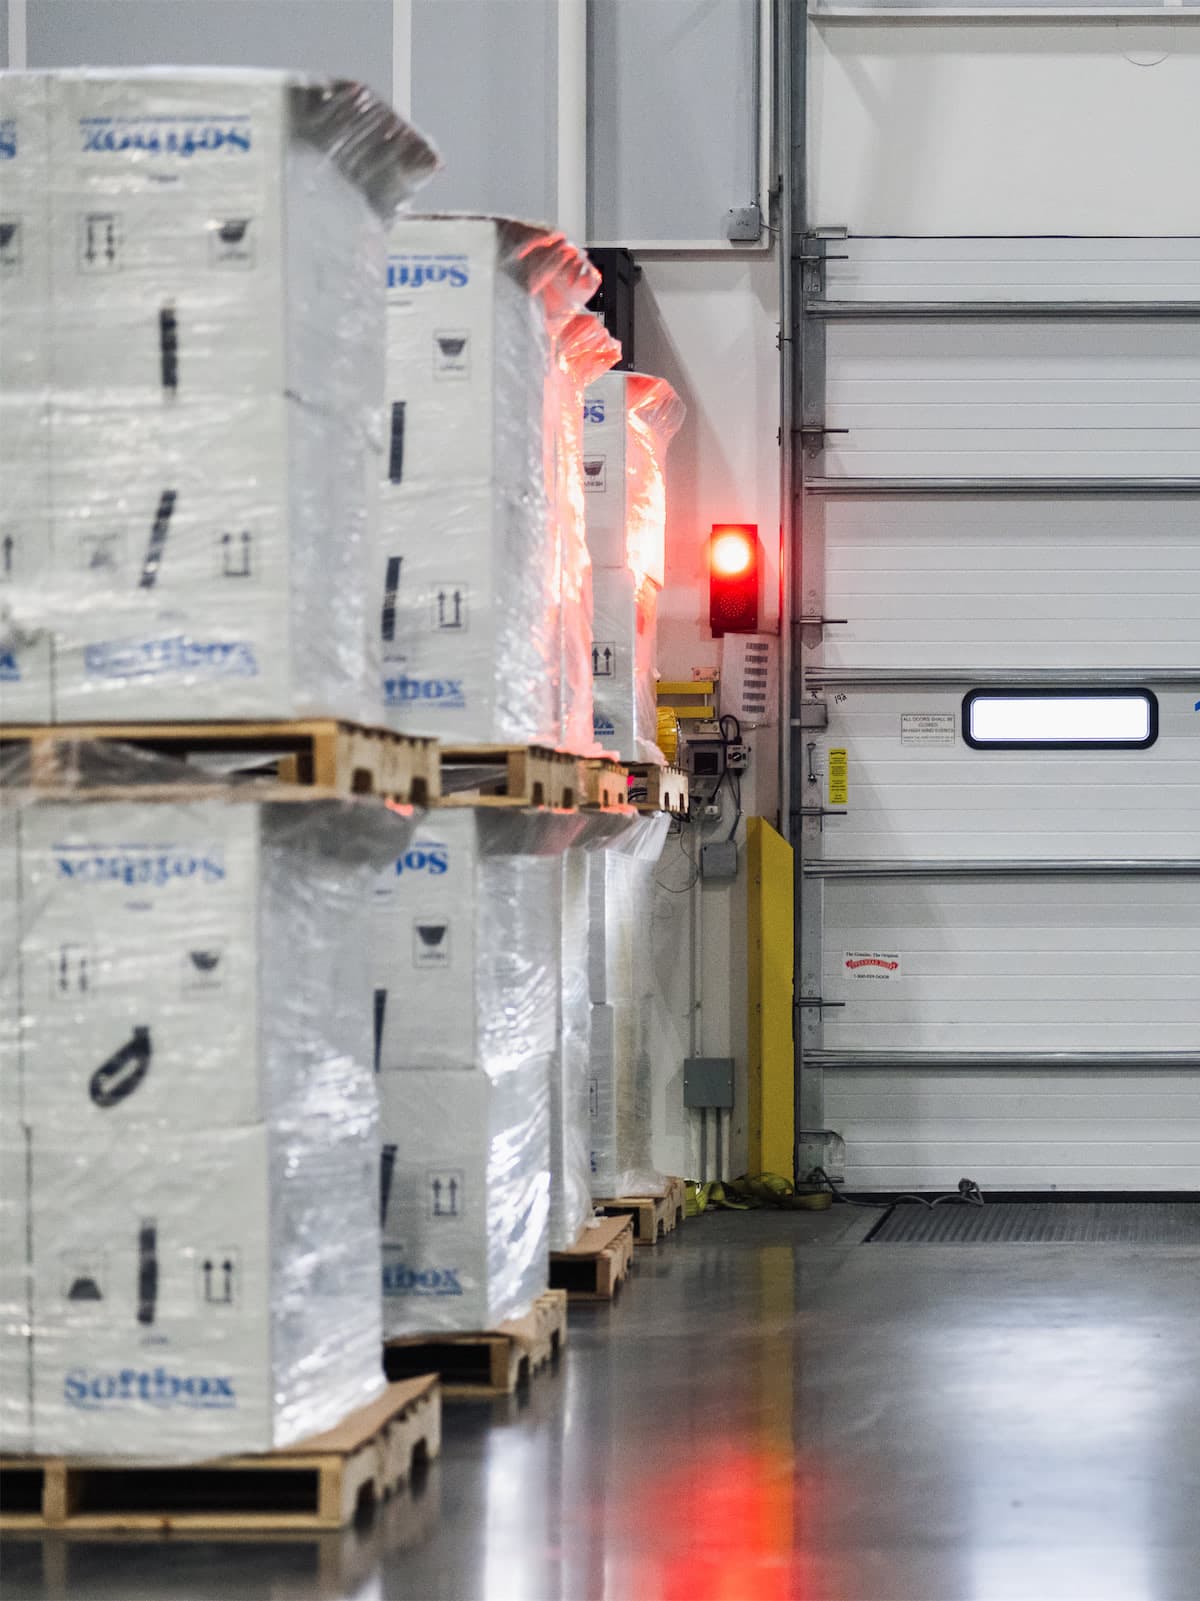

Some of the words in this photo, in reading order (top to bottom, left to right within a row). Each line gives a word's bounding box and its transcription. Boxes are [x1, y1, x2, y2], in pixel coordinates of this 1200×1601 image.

[386, 265, 469, 289] Soft
[383, 675, 464, 699] tbox
[65, 1366, 236, 1399] Softbox
